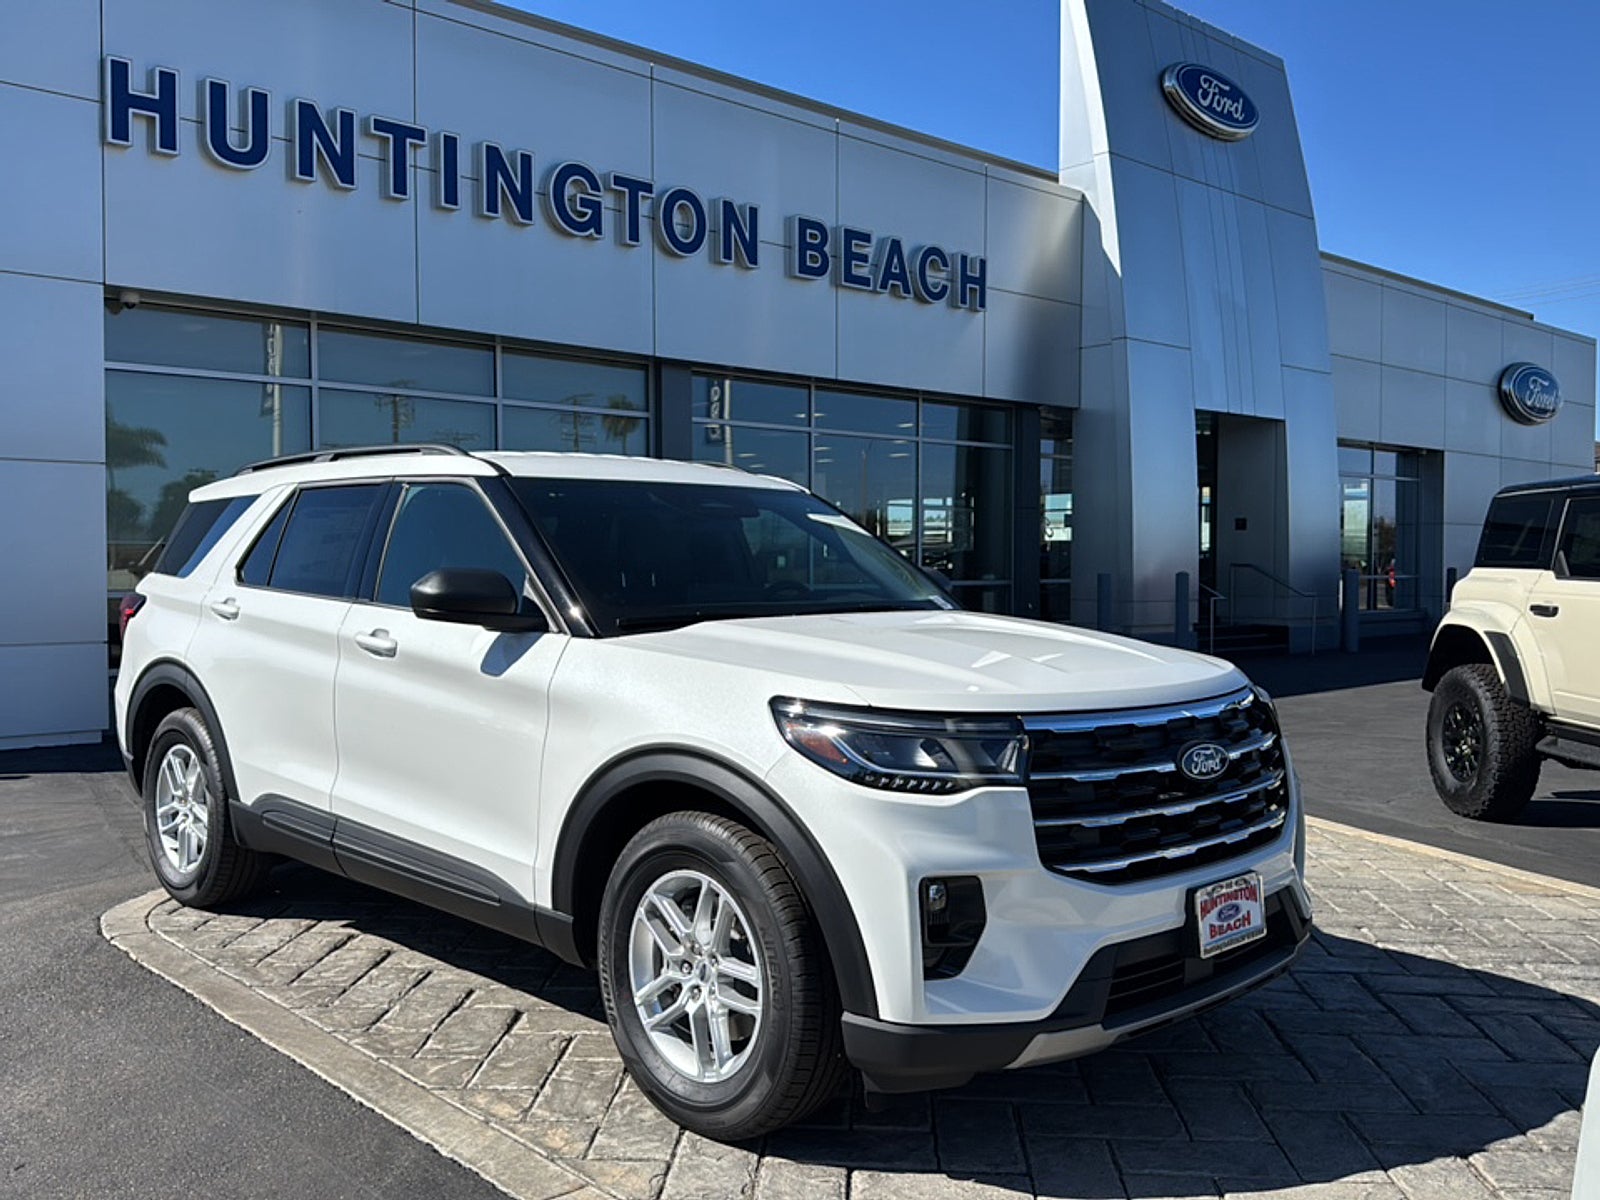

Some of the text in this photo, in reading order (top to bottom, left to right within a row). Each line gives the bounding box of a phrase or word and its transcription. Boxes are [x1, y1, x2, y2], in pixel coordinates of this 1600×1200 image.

[1198, 75, 1245, 121] Ford
[103, 55, 987, 312] HUNTINGTON BEACH
[1525, 376, 1557, 411] Ford
[1191, 747, 1221, 774] Ford
[1200, 883, 1258, 921] HUNTINGTON
[1209, 910, 1251, 939] BEACH
